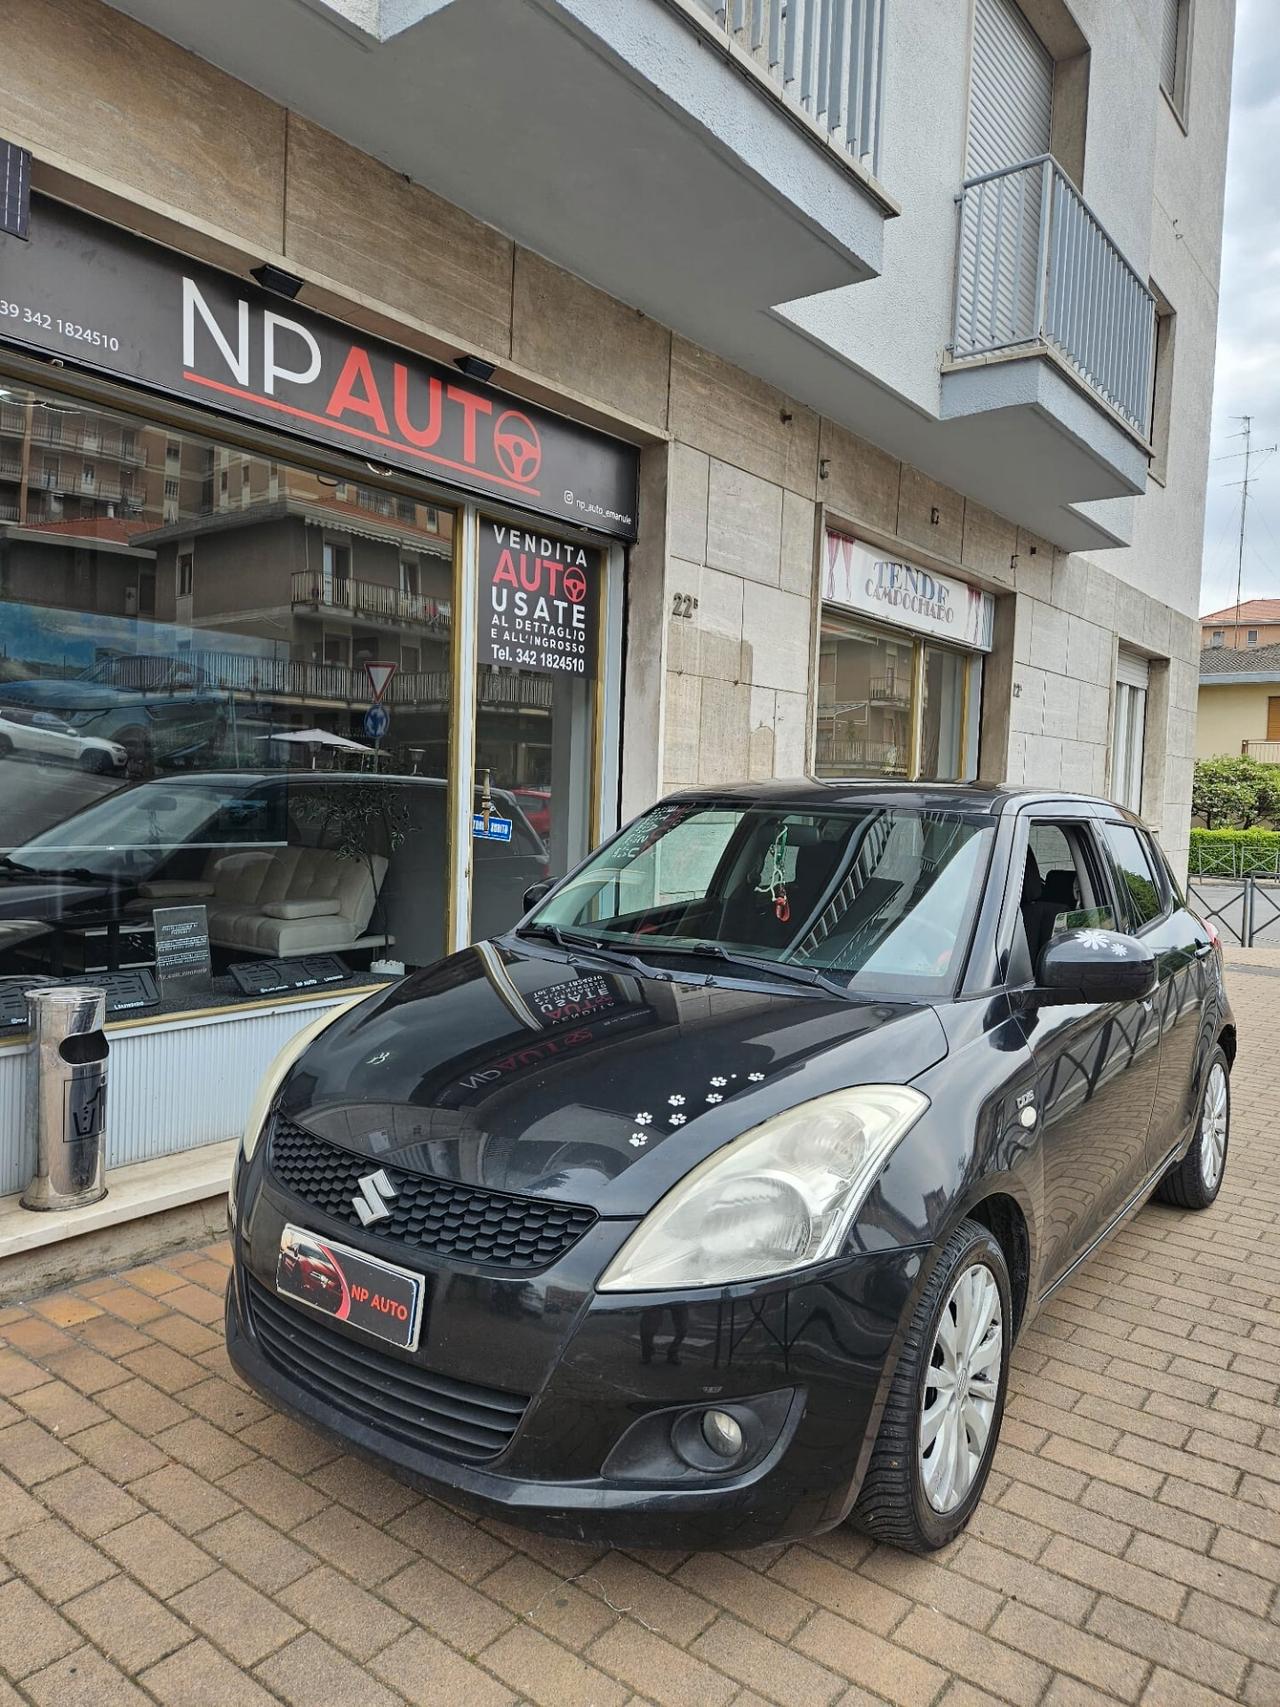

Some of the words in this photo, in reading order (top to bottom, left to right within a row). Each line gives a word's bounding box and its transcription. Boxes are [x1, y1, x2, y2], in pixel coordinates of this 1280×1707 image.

[23, 308, 52, 330] 342
[56, 319, 119, 351] 1824510
[493, 524, 587, 568] VENDITA
[873, 561, 950, 607] TENDE
[491, 586, 586, 629] USATE
[491, 613, 509, 627] AL
[515, 618, 586, 642] DETTAGLIO
[491, 627, 498, 639] E
[503, 630, 586, 654] ALL'INGROSSO
[491, 643, 513, 662] Tel.
[515, 648, 537, 666] 342
[540, 651, 585, 673] 1824510
[351, 1284, 369, 1302] NP
[371, 1294, 408, 1321] AUTO
